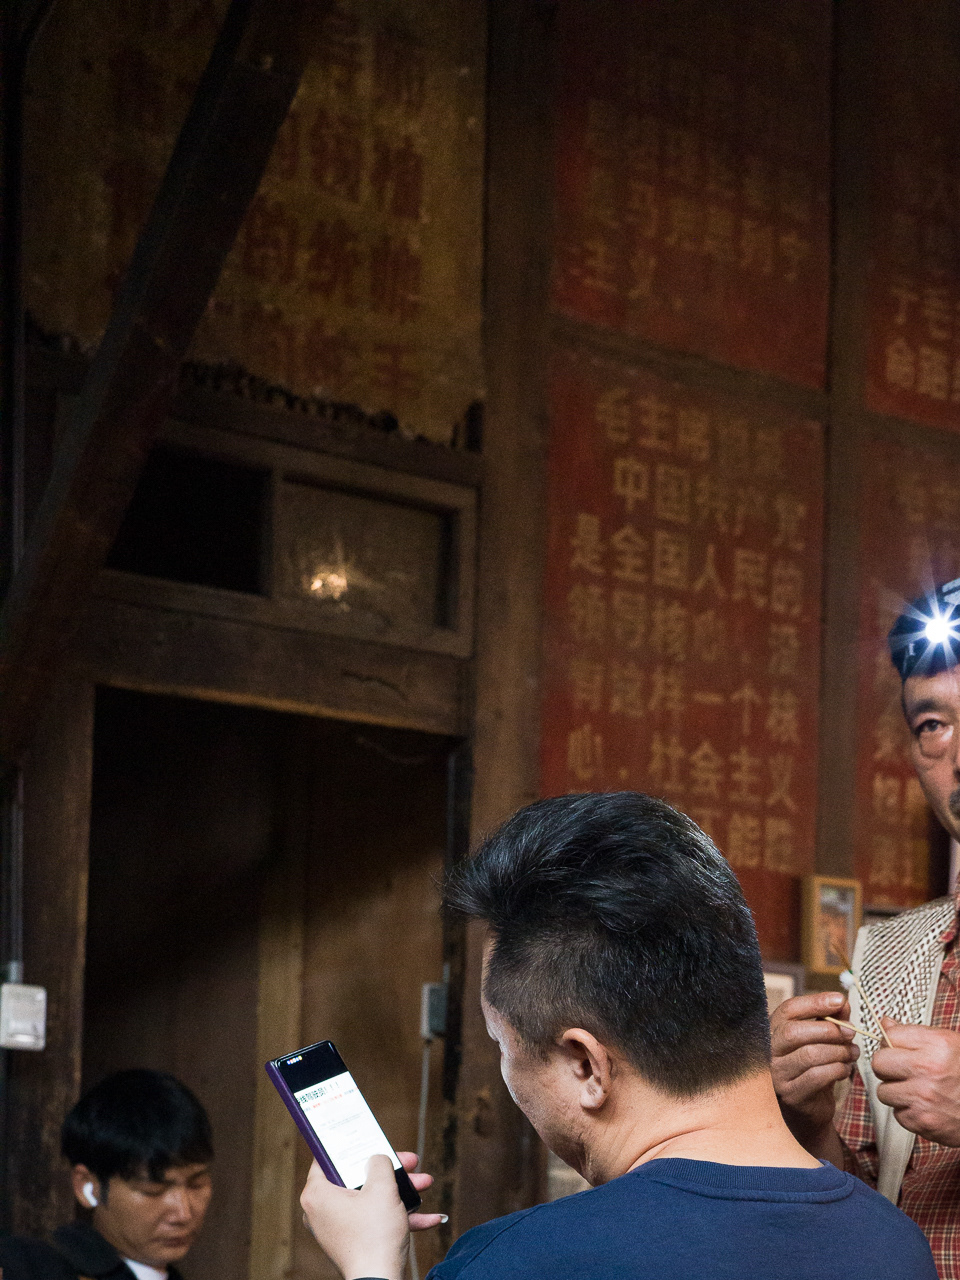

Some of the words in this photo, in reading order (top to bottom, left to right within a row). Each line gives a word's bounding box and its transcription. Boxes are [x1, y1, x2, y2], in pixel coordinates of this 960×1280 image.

[612, 456, 807, 551] 中国共产党
[569, 512, 804, 616] 是全国人民的
